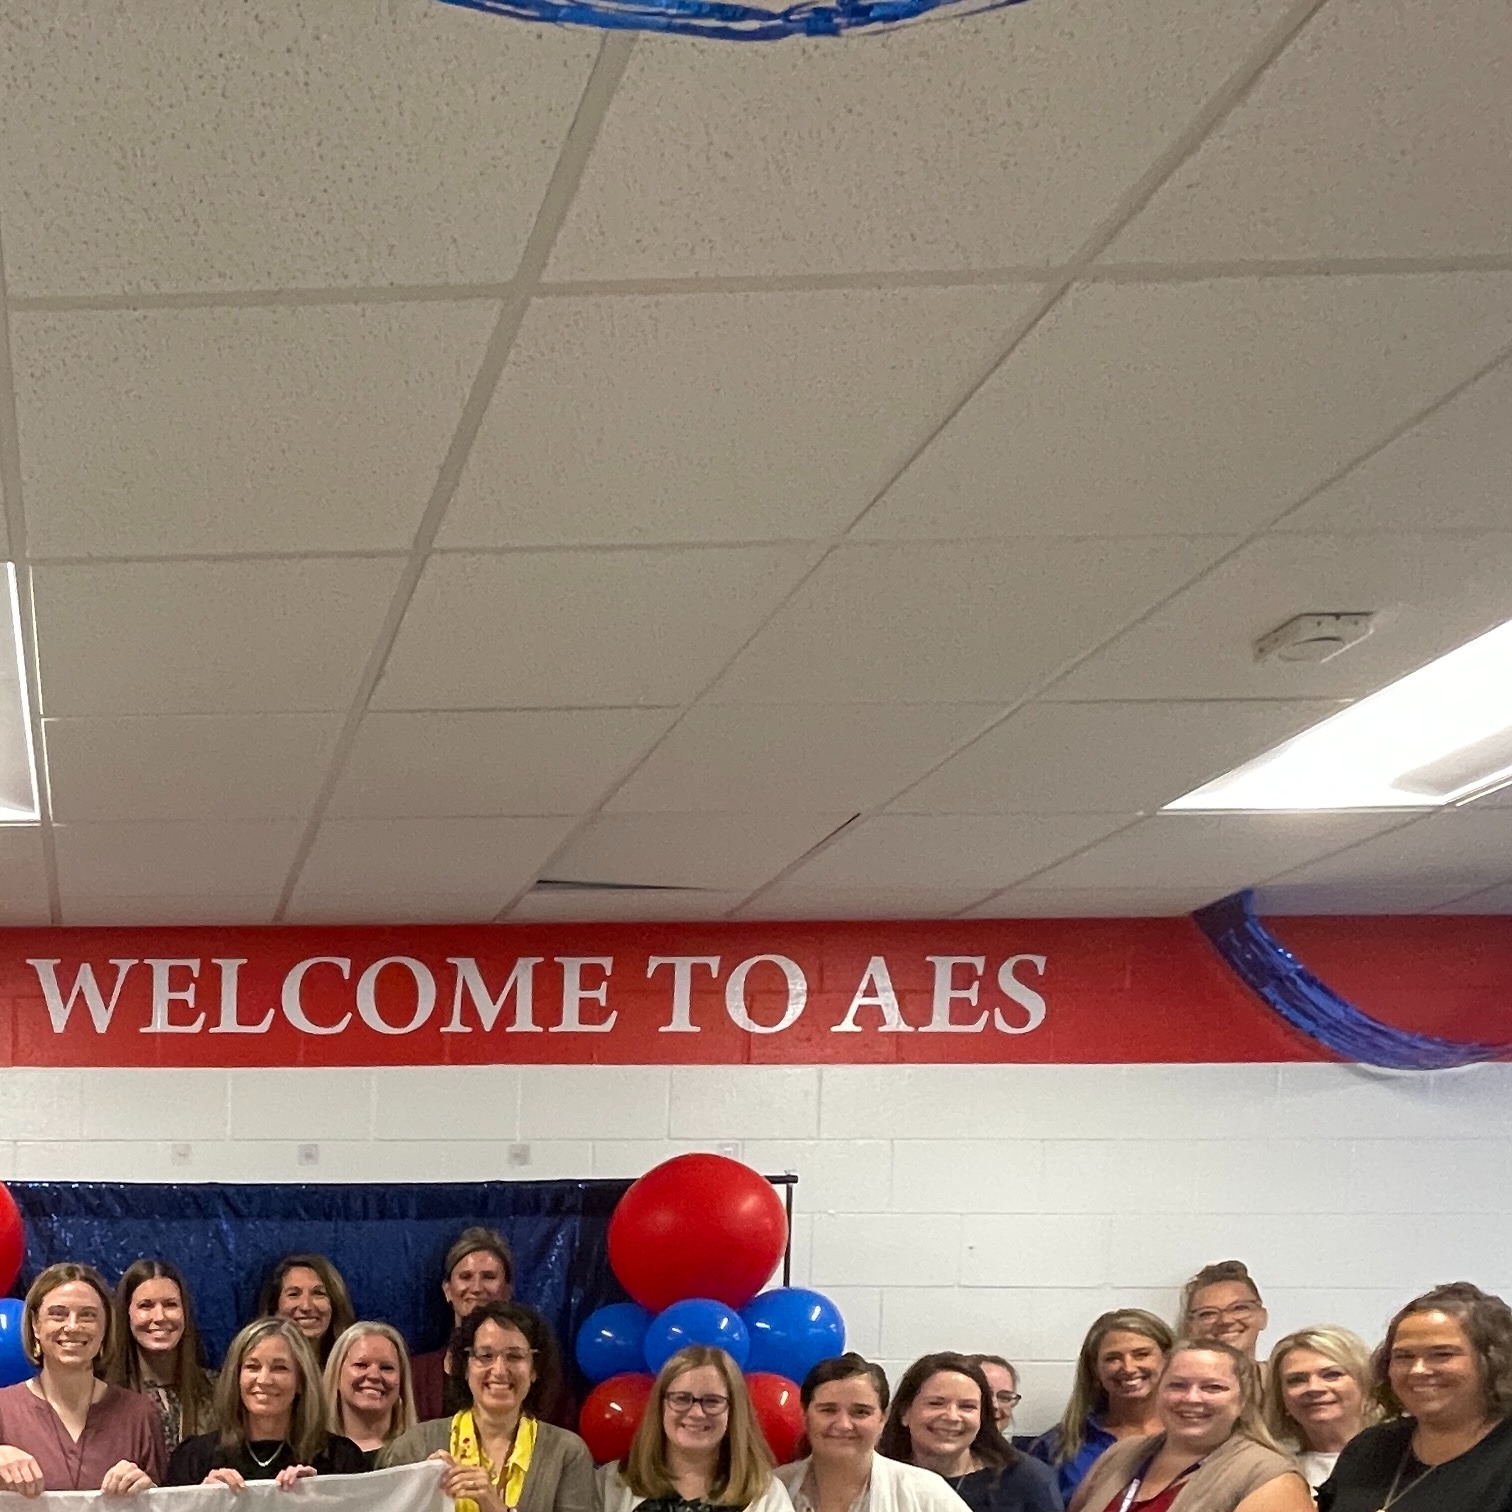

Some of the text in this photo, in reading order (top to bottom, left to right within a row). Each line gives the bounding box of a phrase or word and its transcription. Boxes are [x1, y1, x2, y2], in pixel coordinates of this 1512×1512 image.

[26, 953, 1047, 1035] WELCOME TO AES
